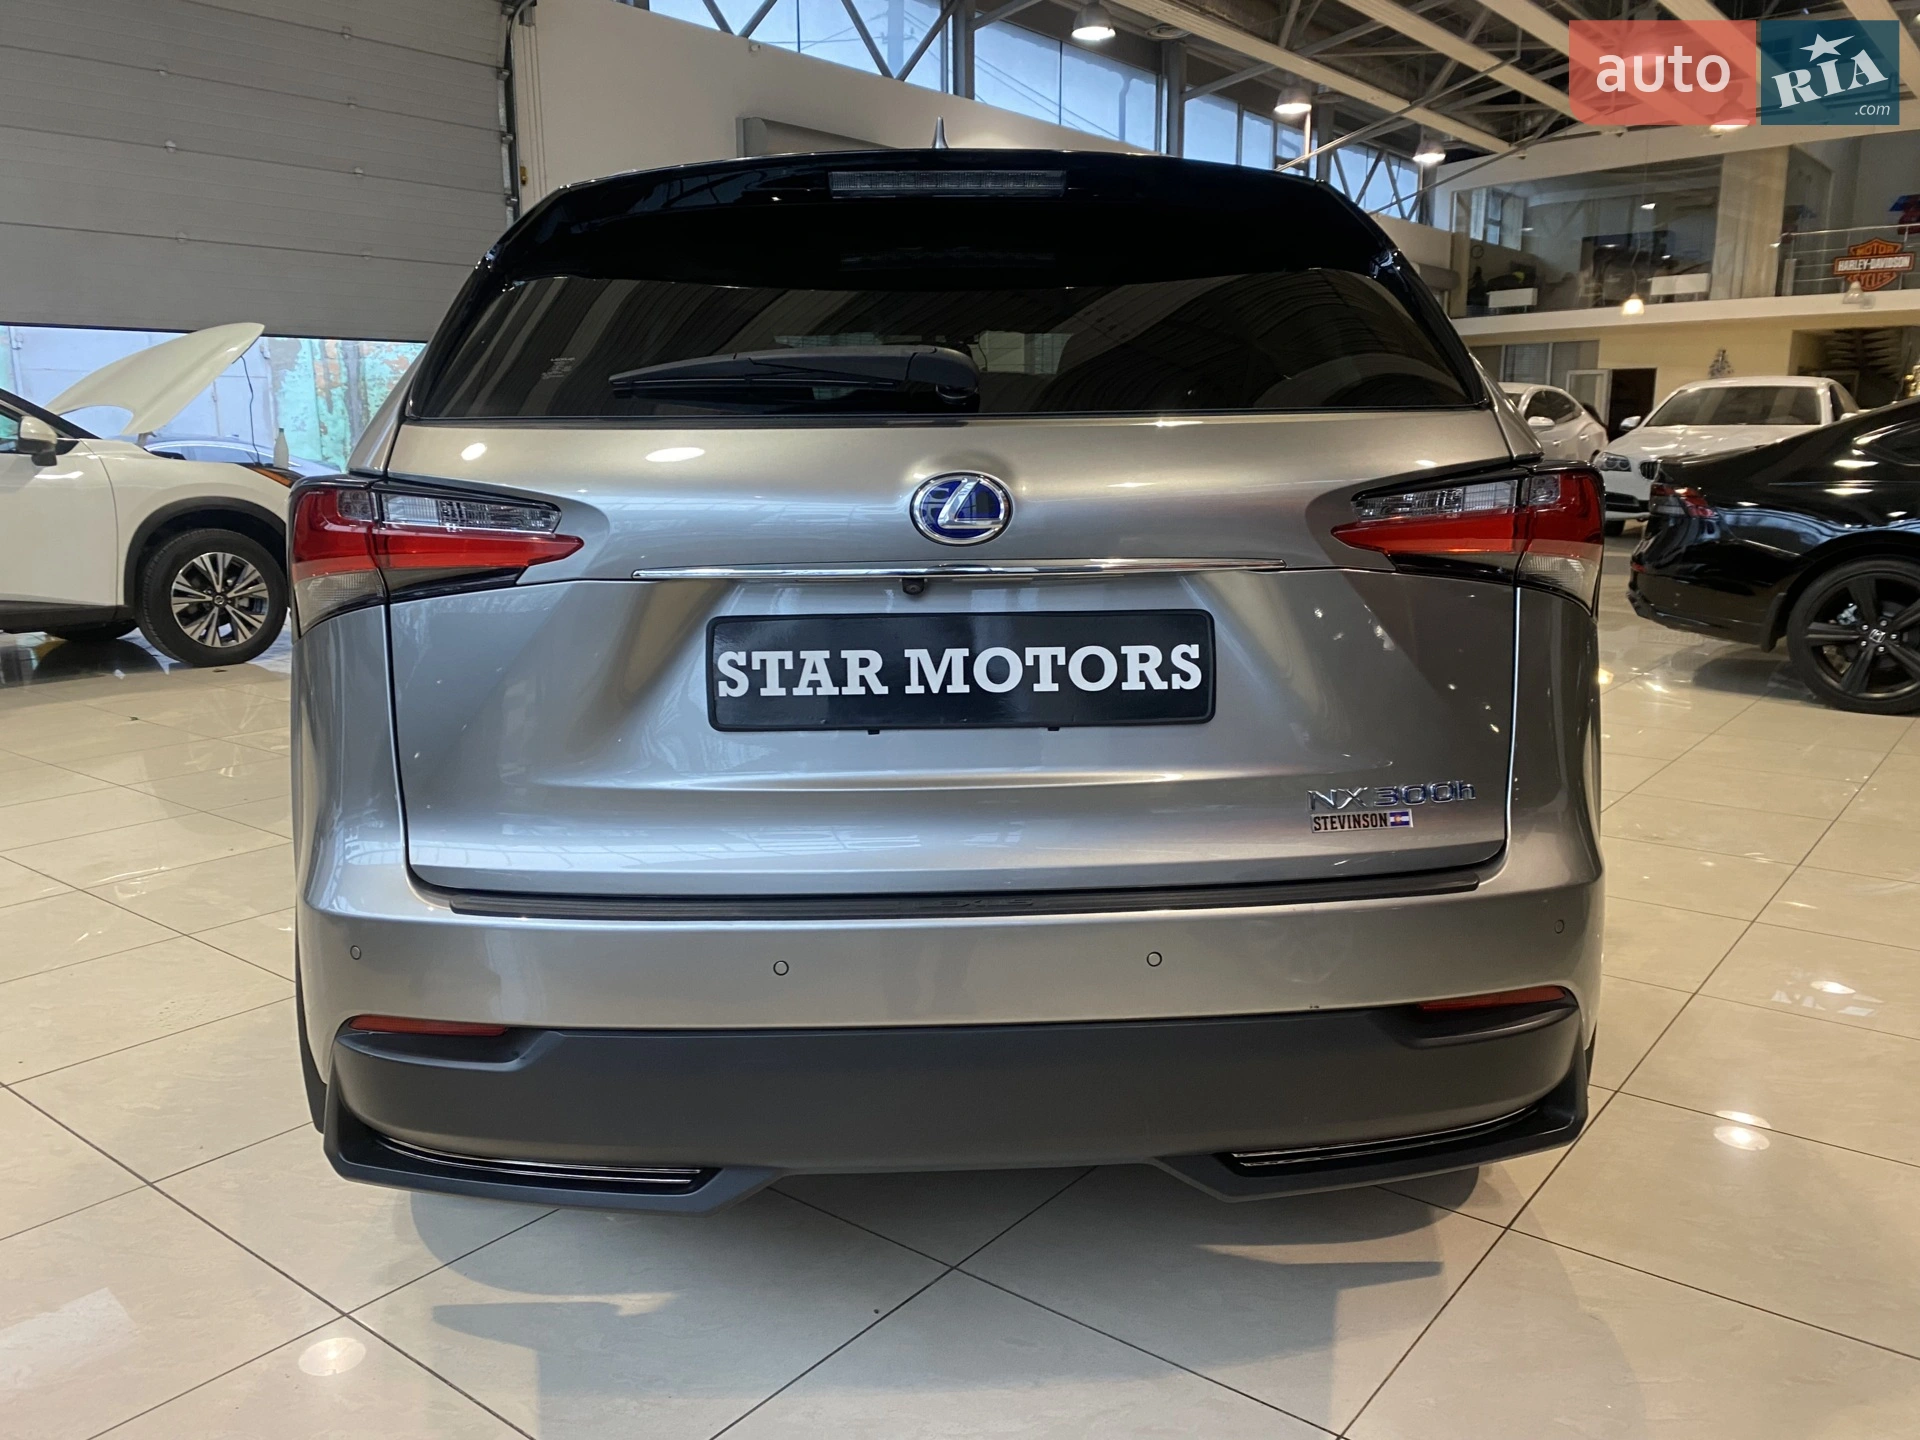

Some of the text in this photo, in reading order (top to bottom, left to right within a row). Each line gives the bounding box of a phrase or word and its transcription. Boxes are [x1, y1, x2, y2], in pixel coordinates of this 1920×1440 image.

[1856, 242, 1894, 256] MOTOR
[1837, 255, 1911, 272] HARLEY-DAVIDSON
[717, 643, 1203, 697] STAR MOTORS
[1307, 779, 1477, 811] NX 300h
[1312, 812, 1388, 832] STEVINSON
